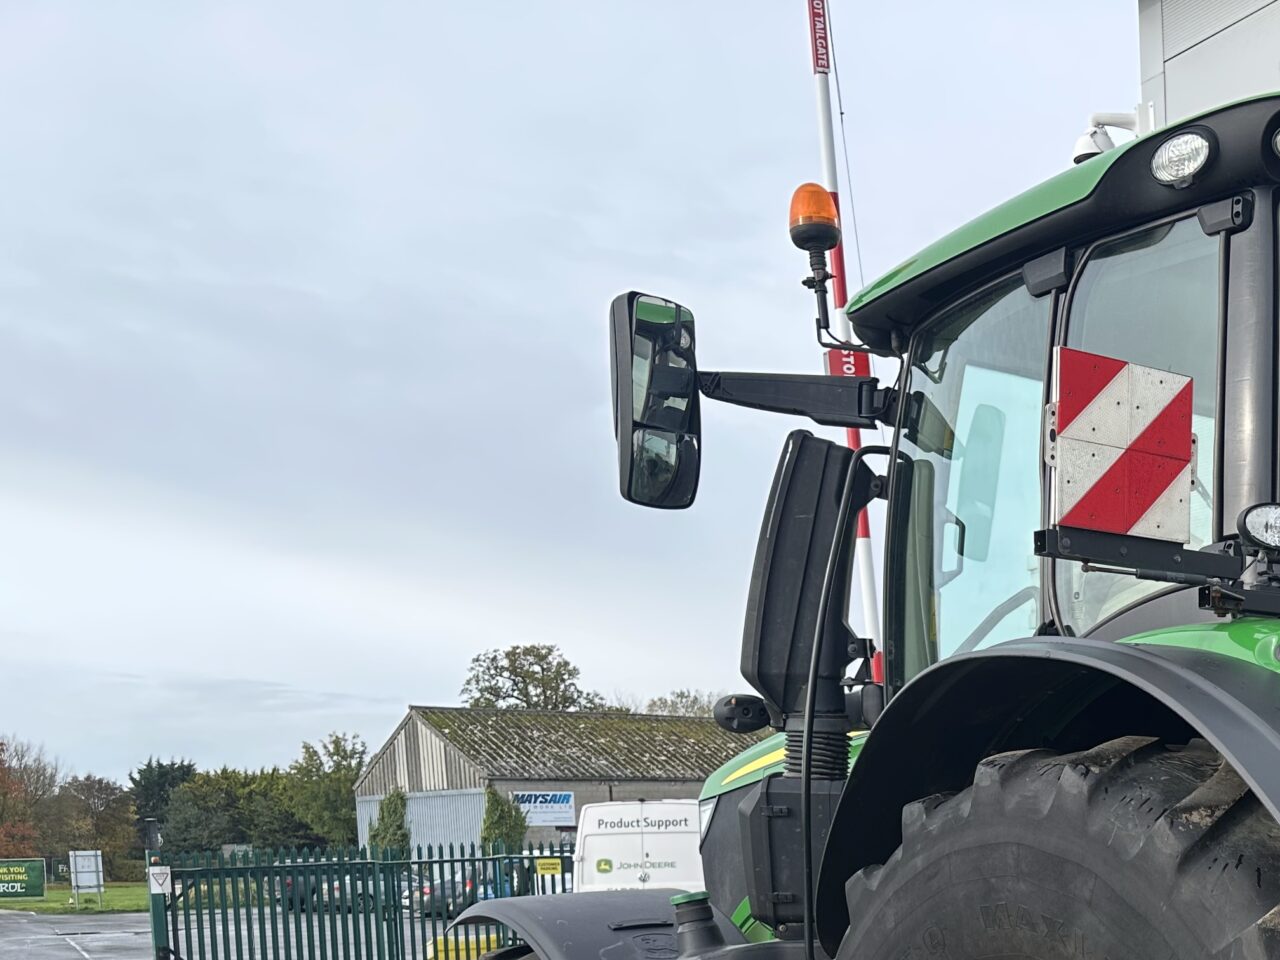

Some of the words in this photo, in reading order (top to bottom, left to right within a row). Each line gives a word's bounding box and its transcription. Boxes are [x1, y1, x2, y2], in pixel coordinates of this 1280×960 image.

[814, 17, 828, 67] TAILGATE
[512, 793, 572, 804] MAYSAIR
[597, 818, 640, 829] Product
[643, 817, 688, 830] Support
[617, 861, 643, 870] JOHN
[644, 861, 676, 869] DEERE
